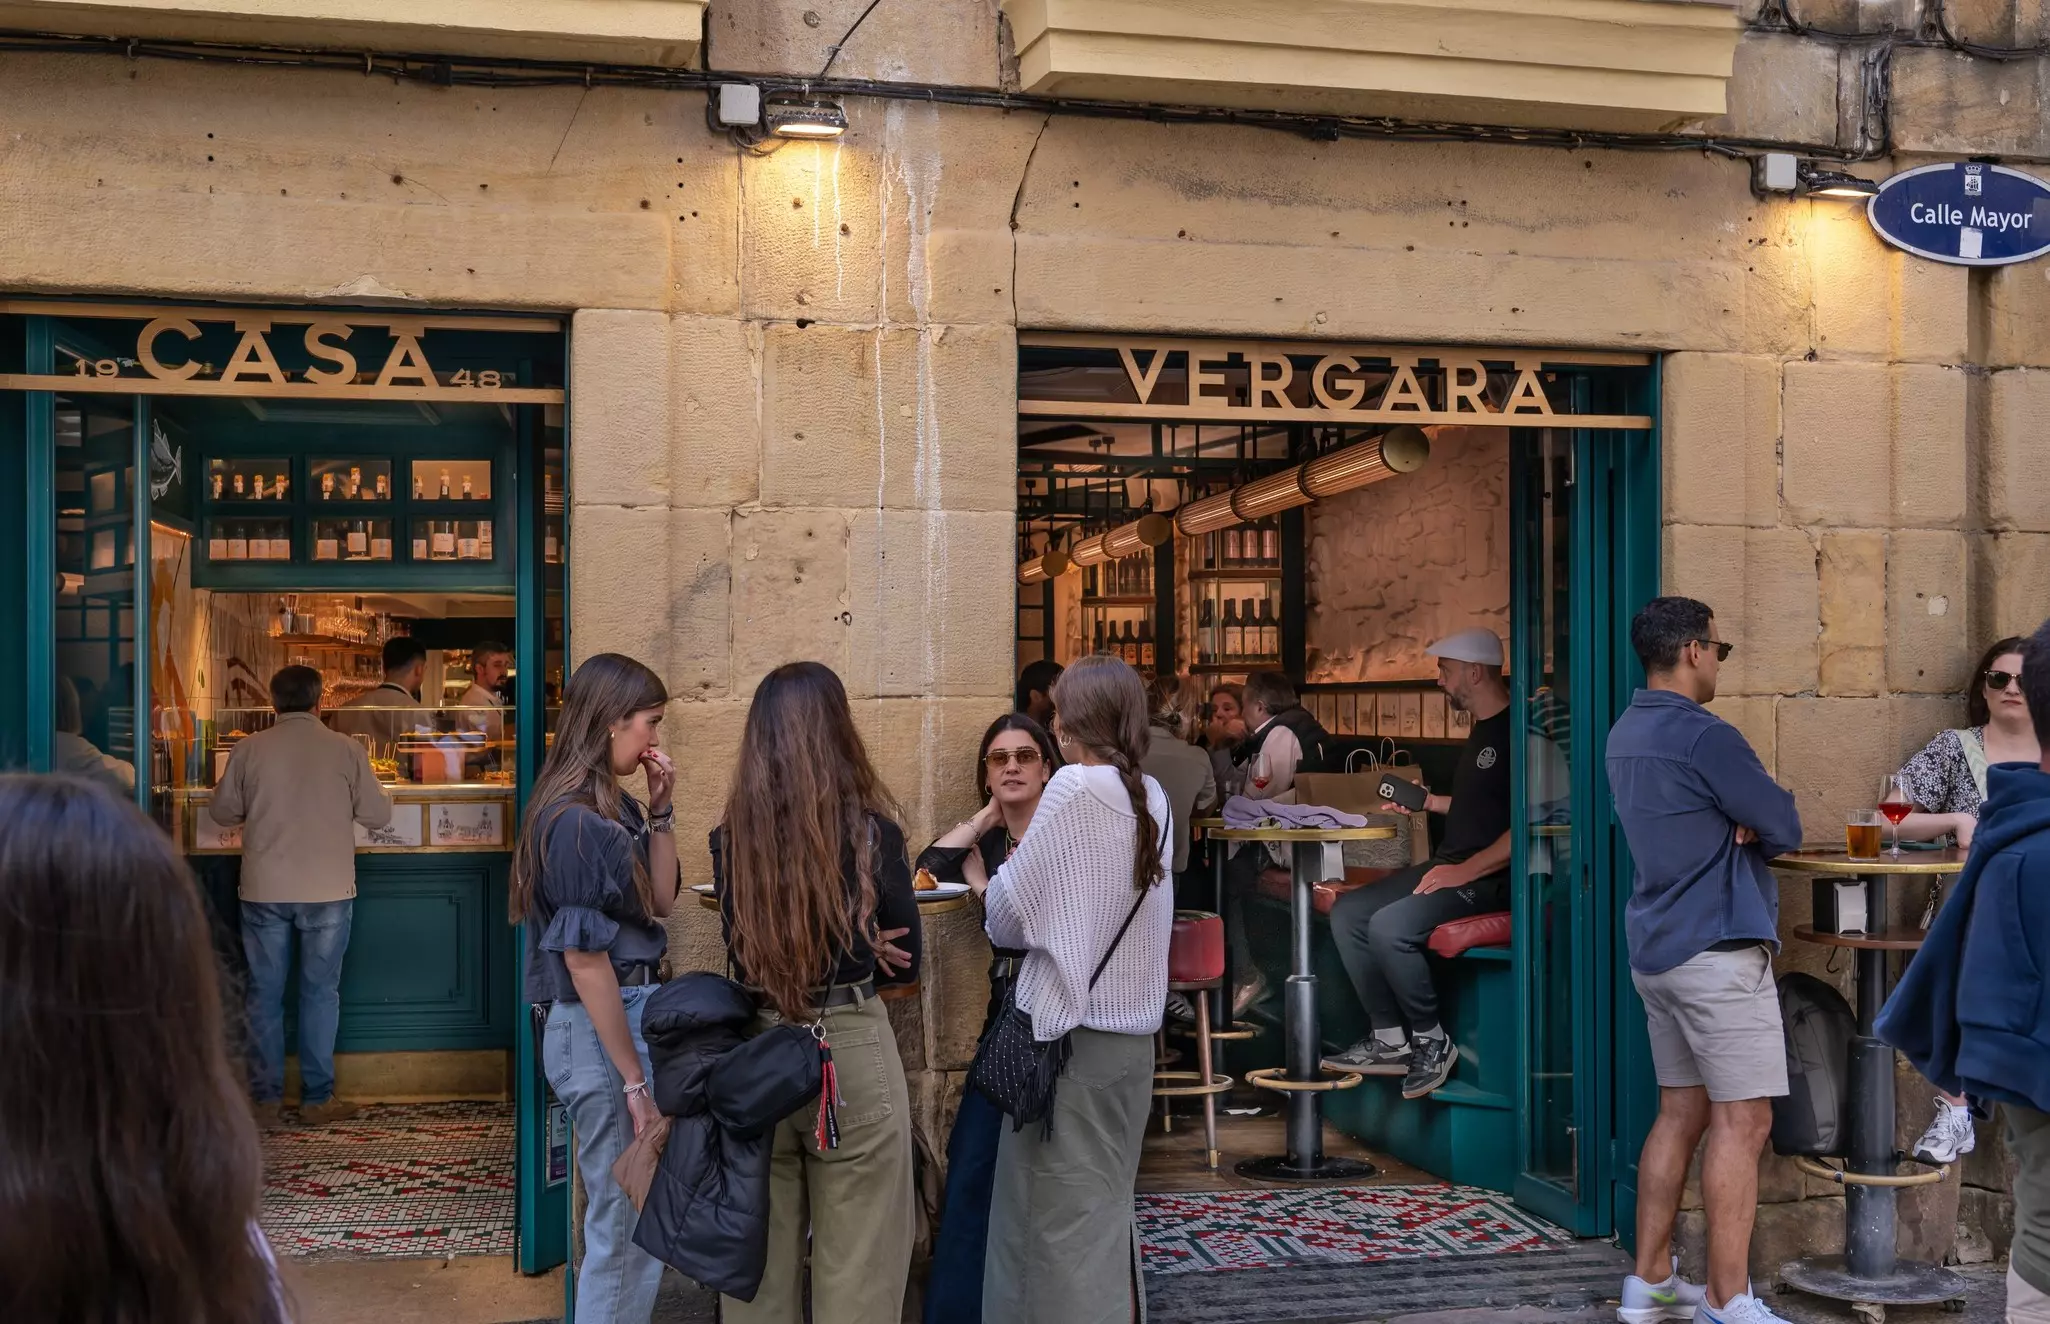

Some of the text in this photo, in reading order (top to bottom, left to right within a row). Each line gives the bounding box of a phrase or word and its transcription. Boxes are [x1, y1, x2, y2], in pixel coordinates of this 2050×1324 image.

[1910, 202, 2033, 232] Calle Mayor
[75, 317, 502, 388] 19 CASA 48
[1117, 348, 1555, 415] VERGARA
